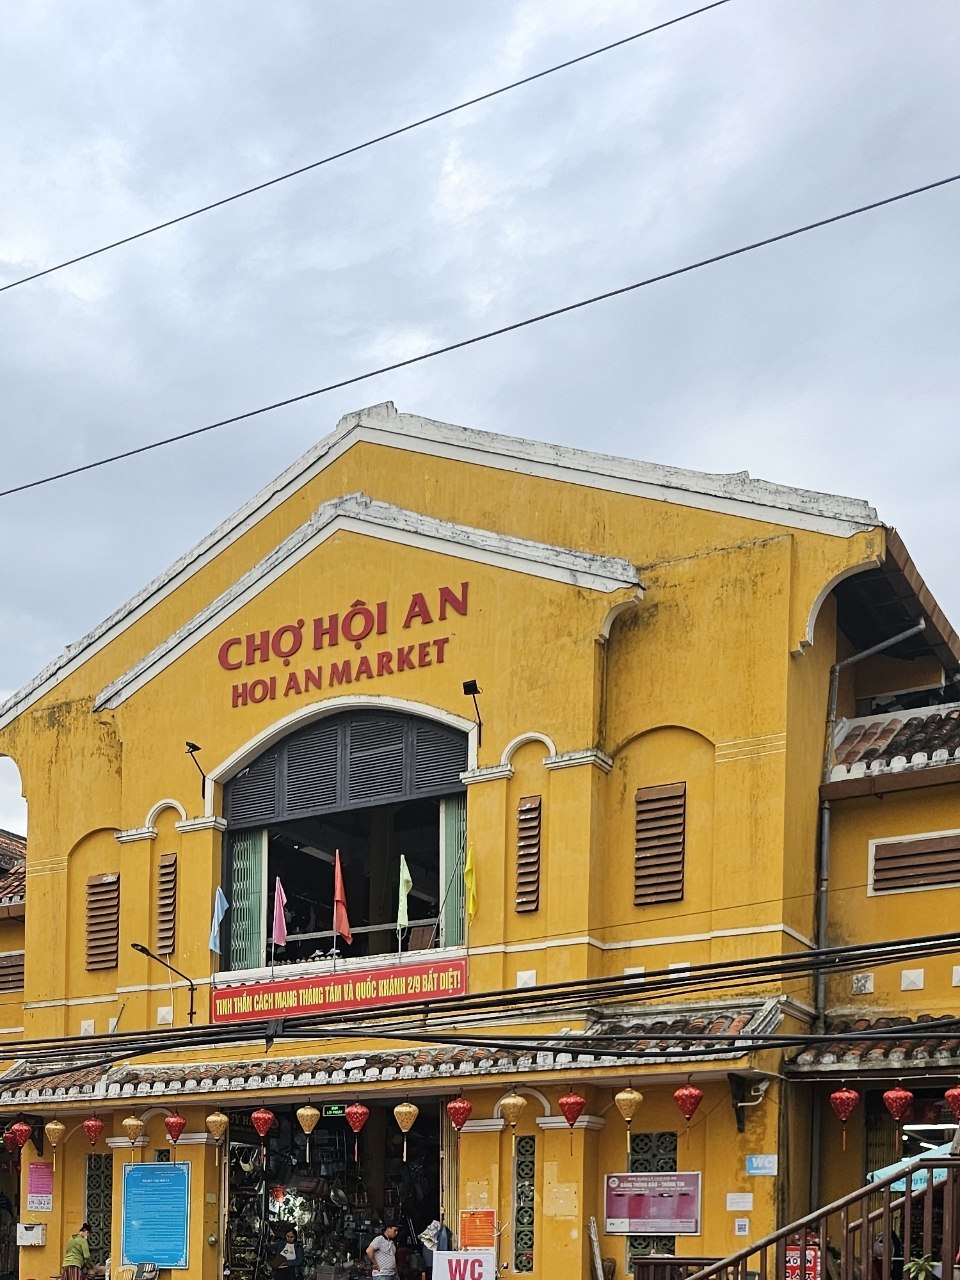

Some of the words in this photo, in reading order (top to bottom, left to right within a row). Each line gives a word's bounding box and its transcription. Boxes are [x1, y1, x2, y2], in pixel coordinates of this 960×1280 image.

[218, 618, 305, 670] CHỢ
[313, 599, 387, 651] HỘI
[402, 582, 469, 629] AN
[232, 676, 277, 708] HOI
[283, 665, 323, 697] AN
[328, 637, 450, 687] MARKET
[253, 991, 274, 1011] CÁCH
[274, 990, 297, 1012] MẠNG
[299, 985, 324, 1006] THÁNG
[325, 982, 342, 1002] TÁM
[343, 980, 354, 1000] VÀ
[355, 975, 377, 1001] QUỐC
[378, 975, 406, 997] KHÁNH
[407, 975, 421, 993] 2/9
[421, 968, 439, 992] BẤT
[439, 968, 461, 993] DIỆT!
[751, 1156, 774, 1168] WC
